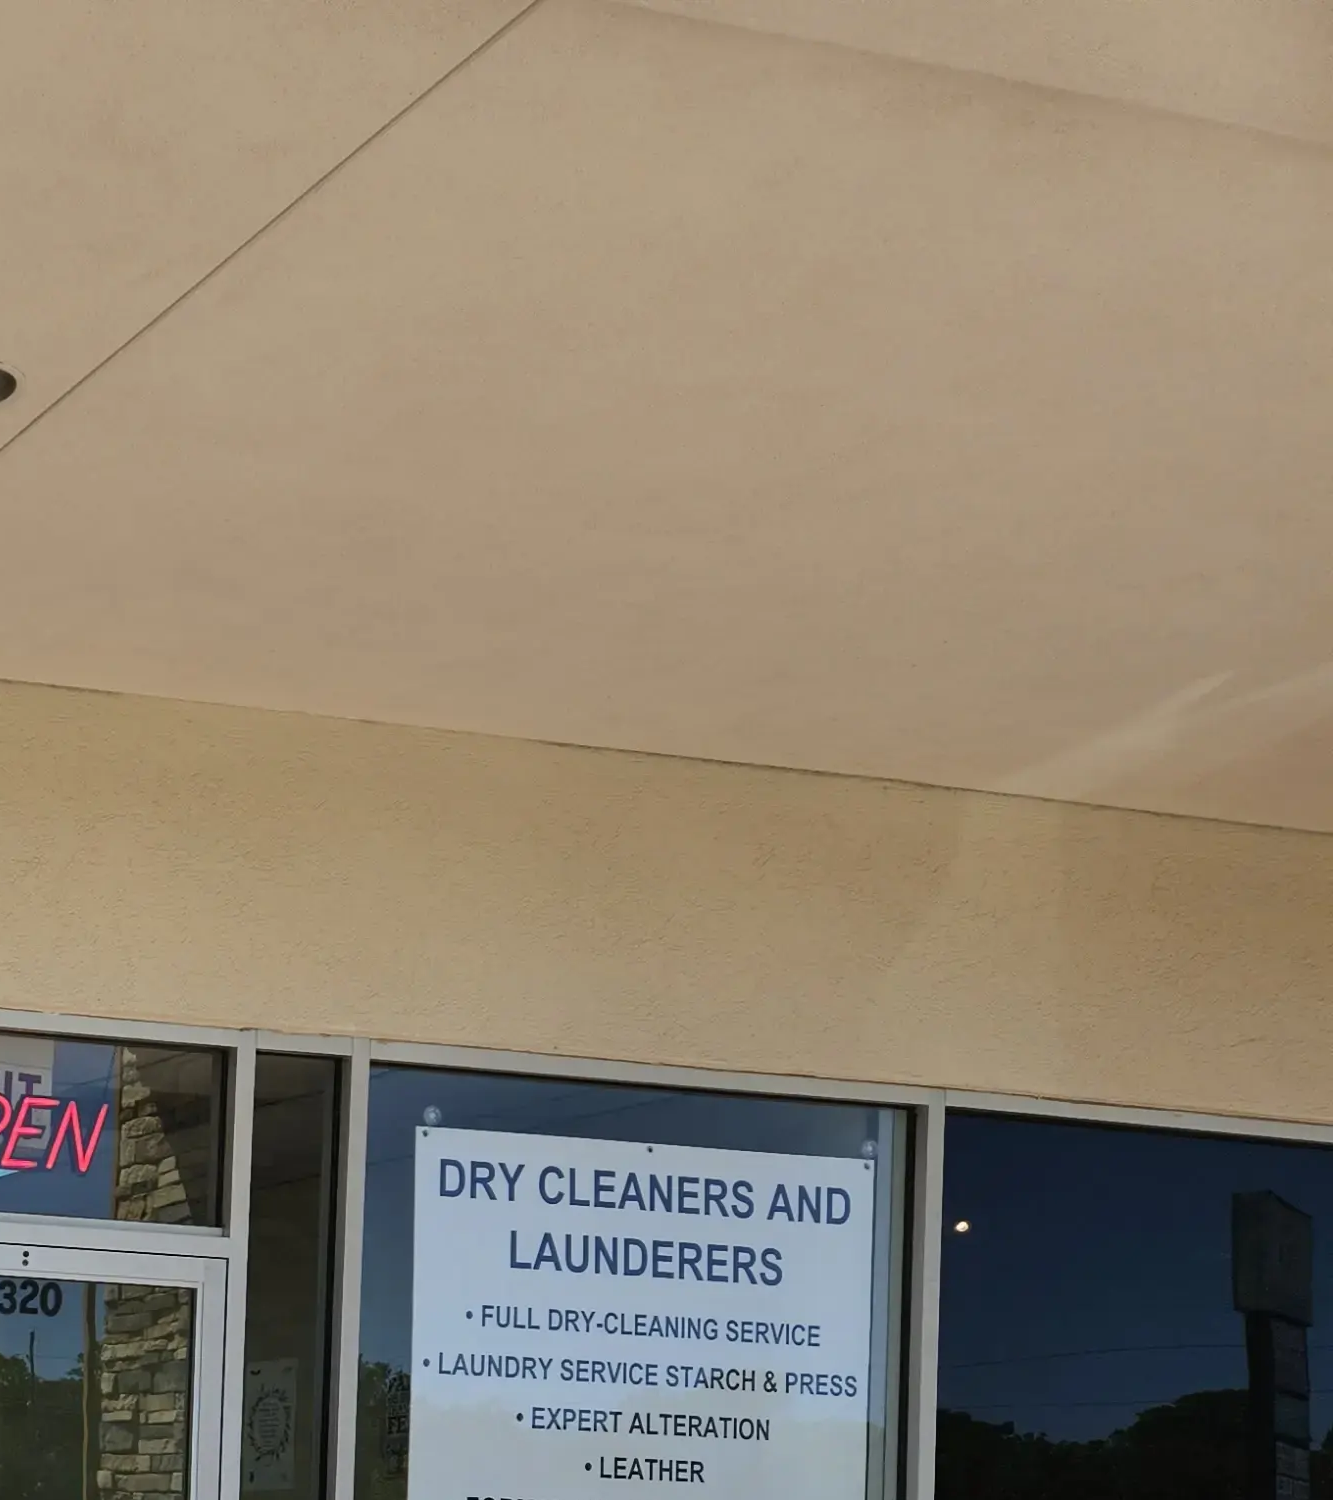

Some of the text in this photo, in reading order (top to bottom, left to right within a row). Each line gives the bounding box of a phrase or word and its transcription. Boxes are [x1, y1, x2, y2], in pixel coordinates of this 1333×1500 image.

[439, 1159, 851, 1225] DRY CLEANERS AND
[509, 1231, 783, 1286] LAUNDERERS
[481, 1305, 820, 1347] FULL DRY-CLEANING SERVICE
[438, 1352, 857, 1397] LAUNDRY SERVICE STARCH & PRESS
[531, 1407, 770, 1441] EXPERT ALTERATION
[600, 1456, 704, 1483] LEATHER
